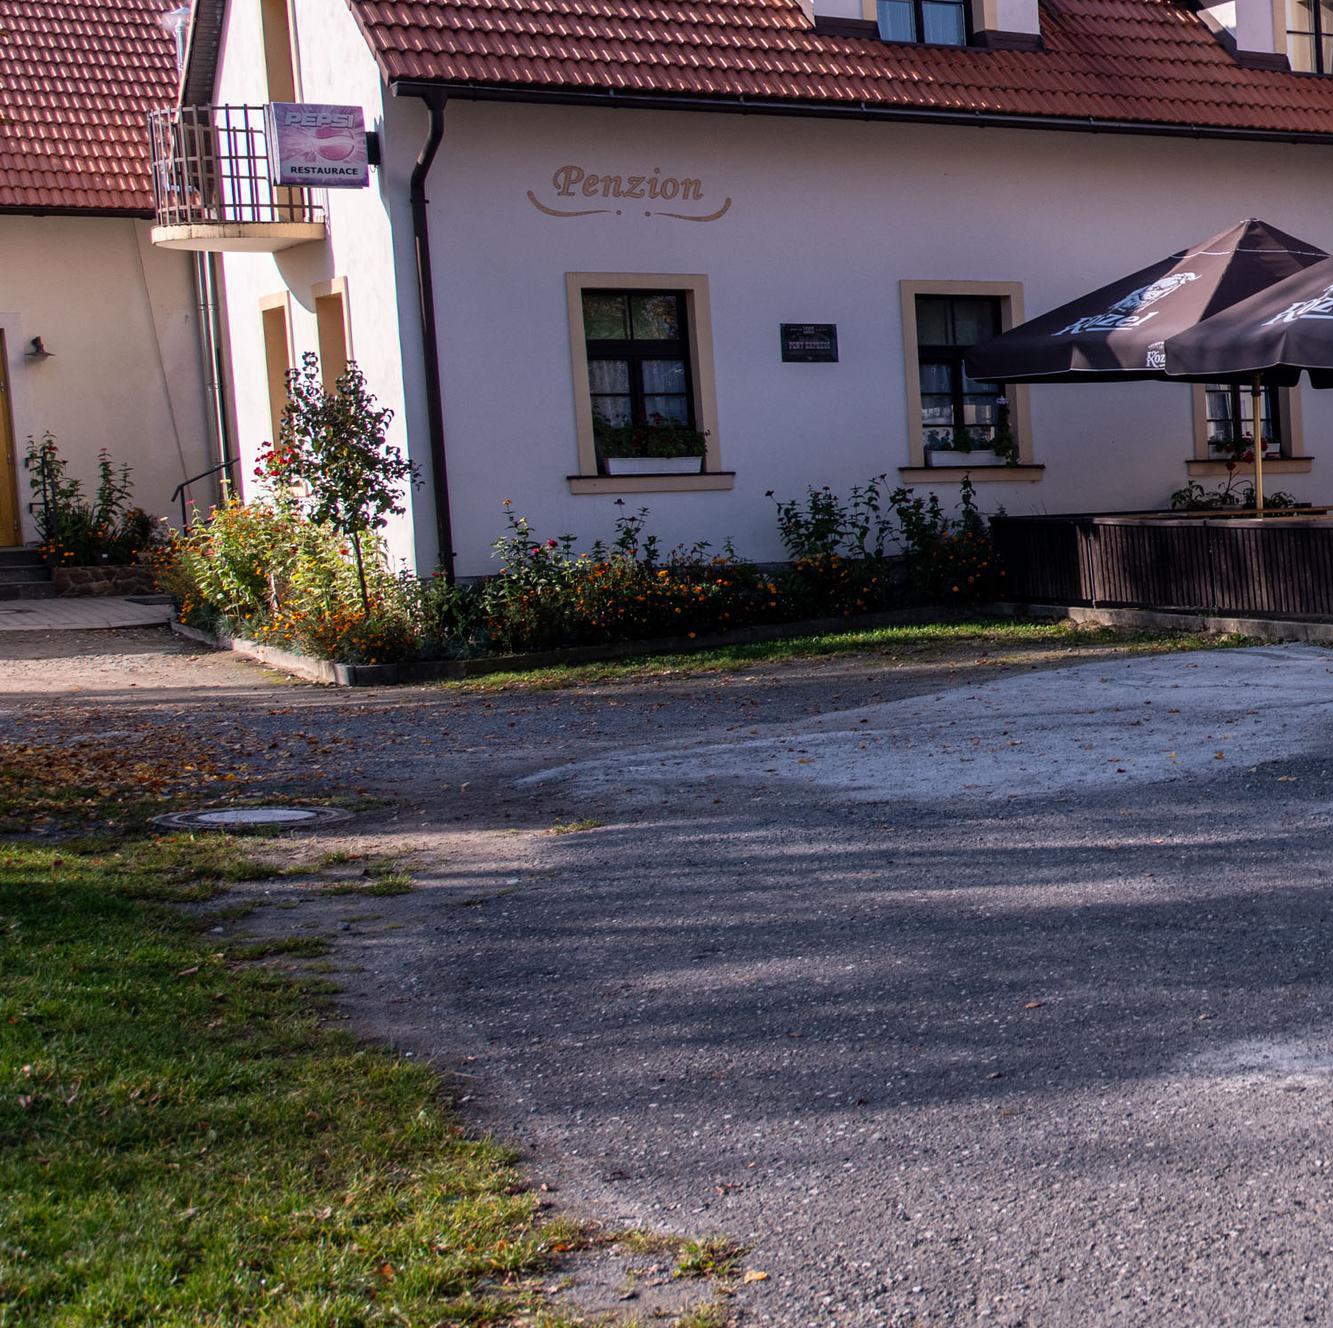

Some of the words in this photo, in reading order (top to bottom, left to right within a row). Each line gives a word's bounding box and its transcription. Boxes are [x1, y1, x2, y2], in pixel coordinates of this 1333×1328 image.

[284, 111, 355, 128] PEPSI
[290, 166, 359, 176] RESTAURACE
[552, 165, 704, 201] Penzion
[1050, 311, 1159, 337] Kozel
[1145, 351, 1166, 368] Koz
